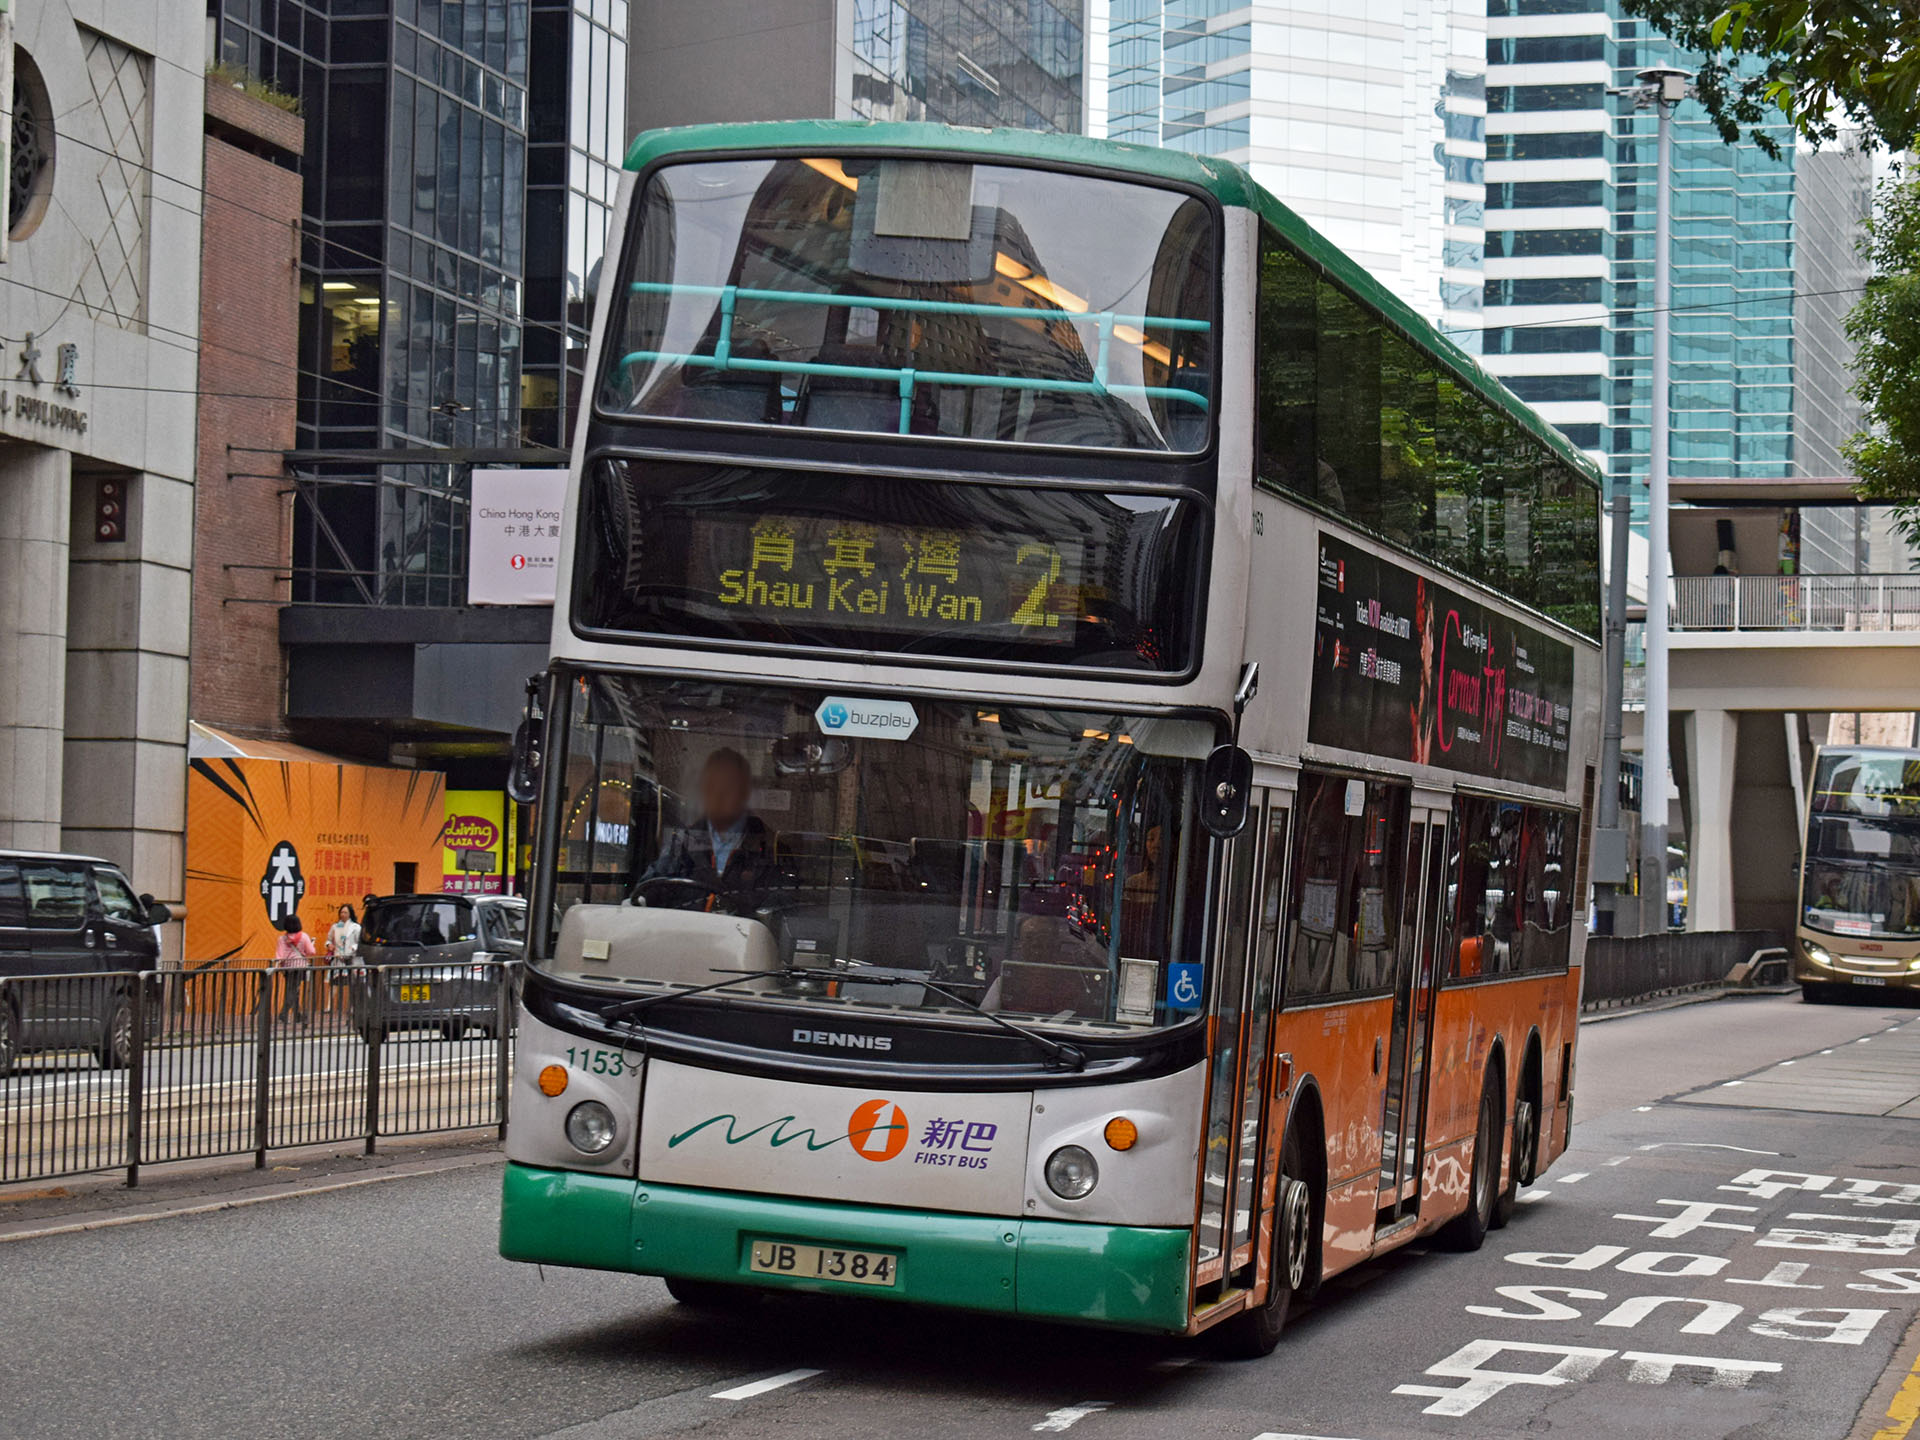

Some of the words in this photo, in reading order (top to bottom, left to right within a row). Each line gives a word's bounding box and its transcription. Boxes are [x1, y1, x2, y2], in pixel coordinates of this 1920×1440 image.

[0, 332, 81, 398] 大廈
[16, 394, 88, 435] BUILDING
[479, 508, 506, 519] China
[508, 508, 534, 521] Hong
[536, 509, 560, 521] Kong
[504, 525, 560, 537] 中港大廈
[750, 515, 961, 584] 筲箕灣
[718, 569, 814, 609] Shau
[828, 577, 889, 615] Kei
[904, 583, 983, 622] Wan
[851, 710, 912, 728] buzplay
[445, 815, 493, 848] Living
[446, 838, 474, 846] PLAZA
[793, 1028, 893, 1051] DENNIS
[566, 1046, 624, 1076] 1153
[920, 1117, 998, 1153] 新巴
[914, 1152, 957, 1167] FIRST
[958, 1155, 989, 1170] BUS
[758, 1244, 796, 1270] JB
[816, 1249, 889, 1281] 1384
[1464, 1285, 1890, 1346] BUS
